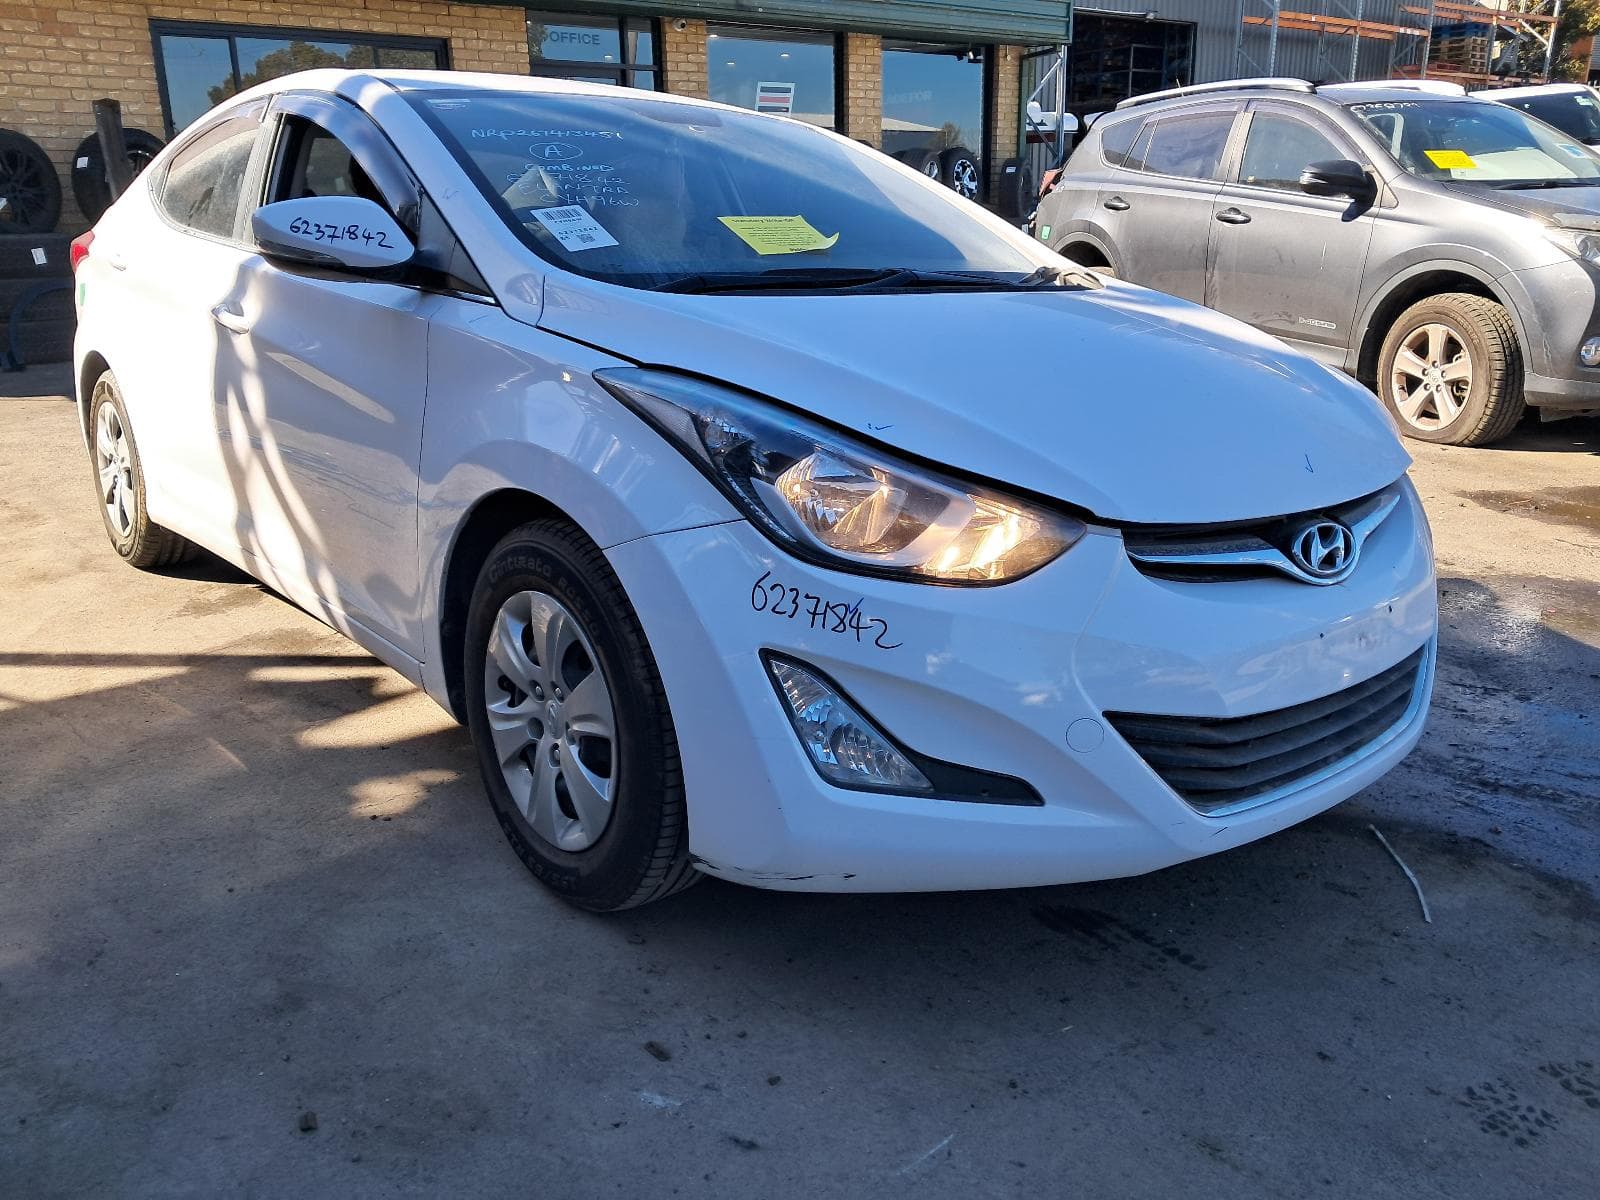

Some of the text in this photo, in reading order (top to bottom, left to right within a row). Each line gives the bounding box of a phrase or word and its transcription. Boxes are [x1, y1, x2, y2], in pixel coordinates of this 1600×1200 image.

[549, 30, 601, 45] OFFICE
[544, 144, 563, 158] A
[289, 216, 395, 249] 62371842
[751, 570, 904, 650] 62371842
